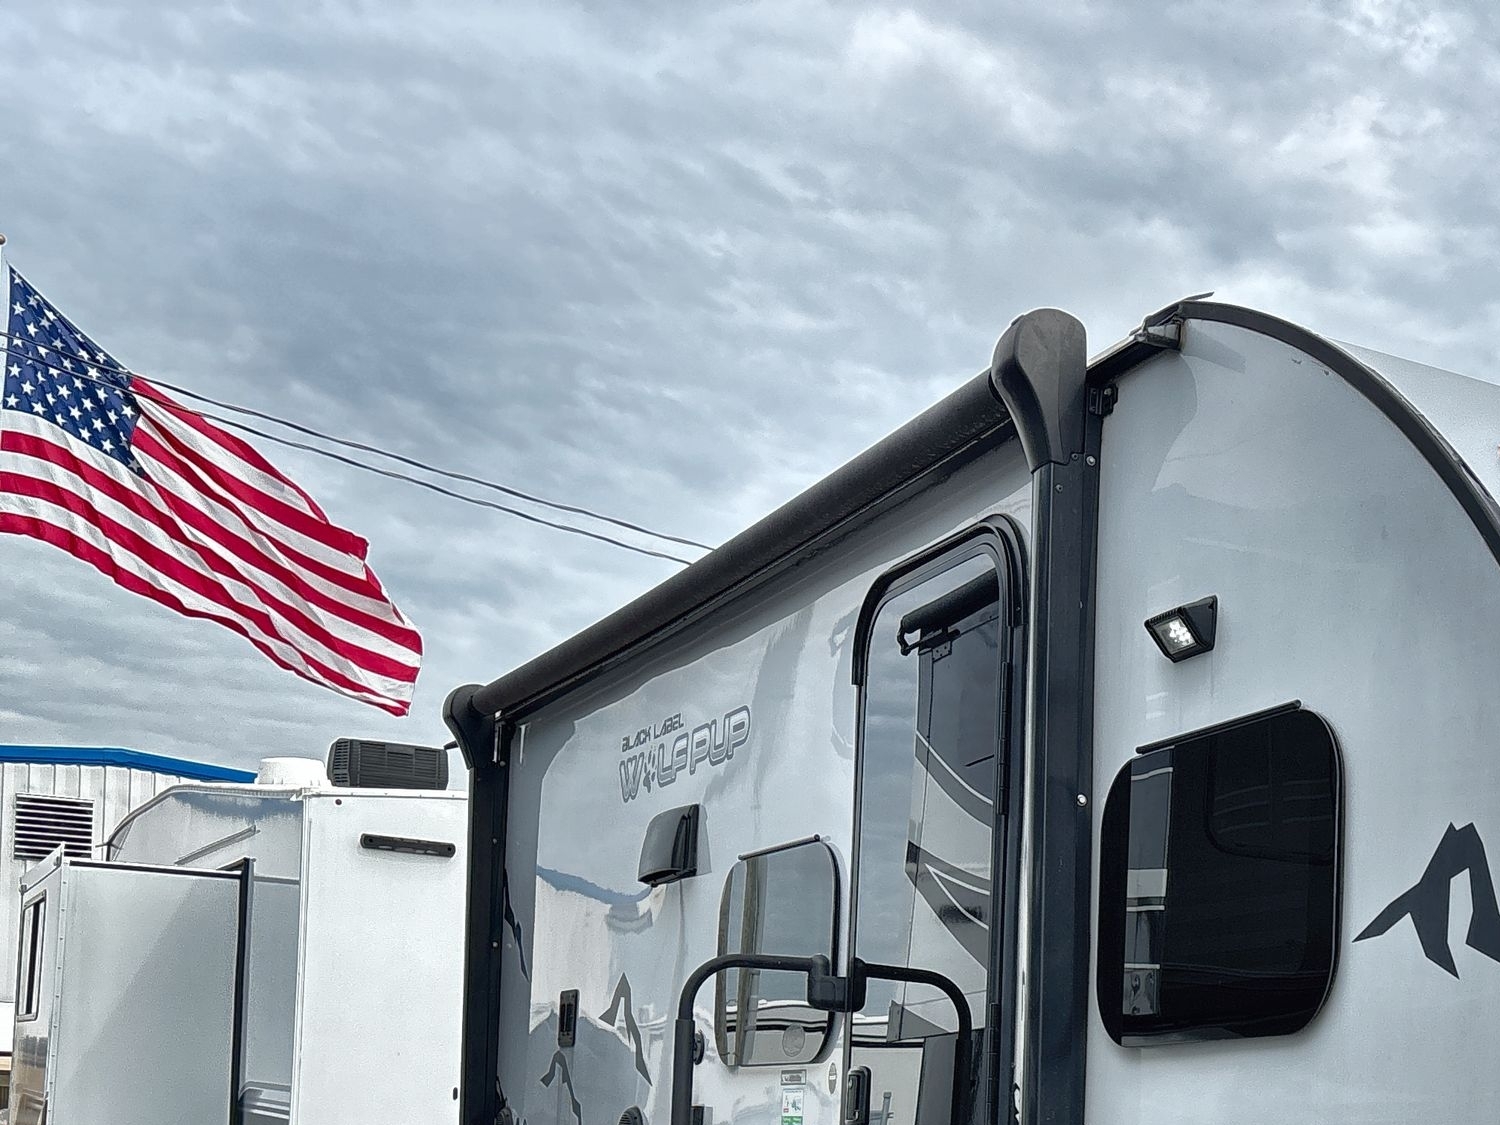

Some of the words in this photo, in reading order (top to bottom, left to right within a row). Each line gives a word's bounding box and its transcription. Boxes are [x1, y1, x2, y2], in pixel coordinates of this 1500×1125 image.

[622, 726, 651, 752] BLACK
[653, 713, 684, 739] LABEL
[689, 705, 751, 775] PUP
